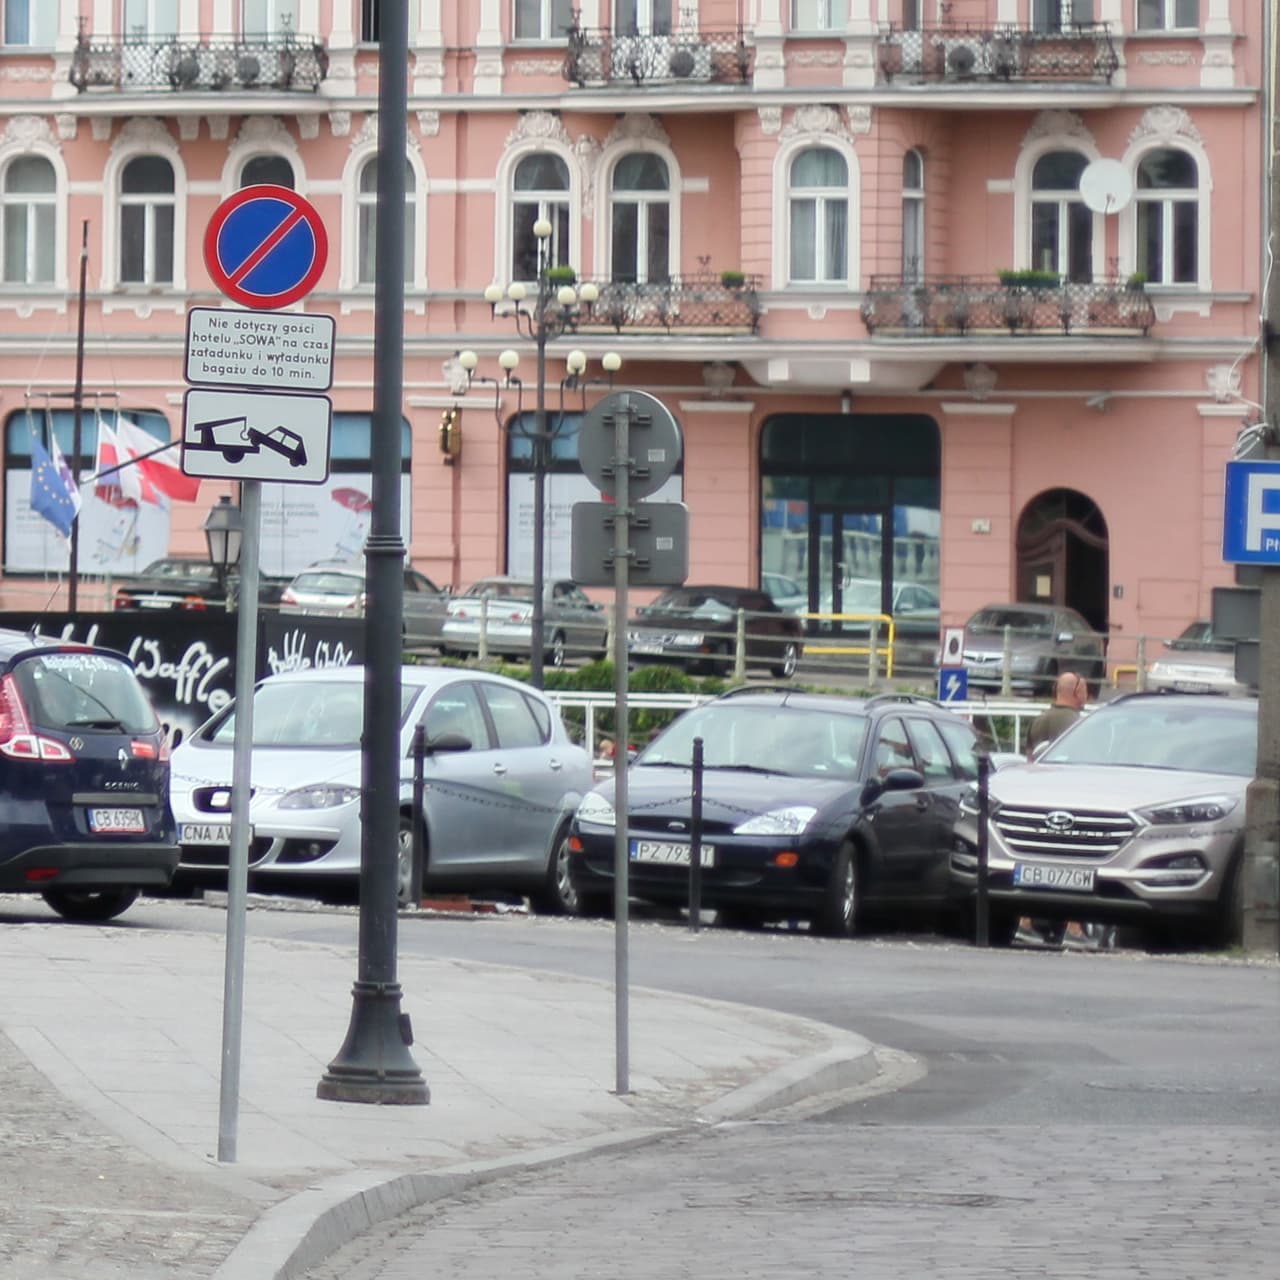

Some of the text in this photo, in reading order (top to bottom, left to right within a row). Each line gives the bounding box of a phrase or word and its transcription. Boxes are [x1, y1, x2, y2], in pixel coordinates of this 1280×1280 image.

[208, 317, 229, 329] Nie
[234, 319, 278, 334] dotyczy
[192, 331, 231, 344] hotelu
[282, 339, 298, 348] na
[302, 340, 329, 350] czas
[191, 347, 253, 360] załadunku
[266, 352, 329, 365] wyładunku
[202, 362, 315, 380] bagażu do 10 min.
[95, 810, 113, 827] CB
[183, 825, 212, 841] CNA
[639, 842, 711, 863] PZ 793T
[1022, 866, 1043, 883] CB
